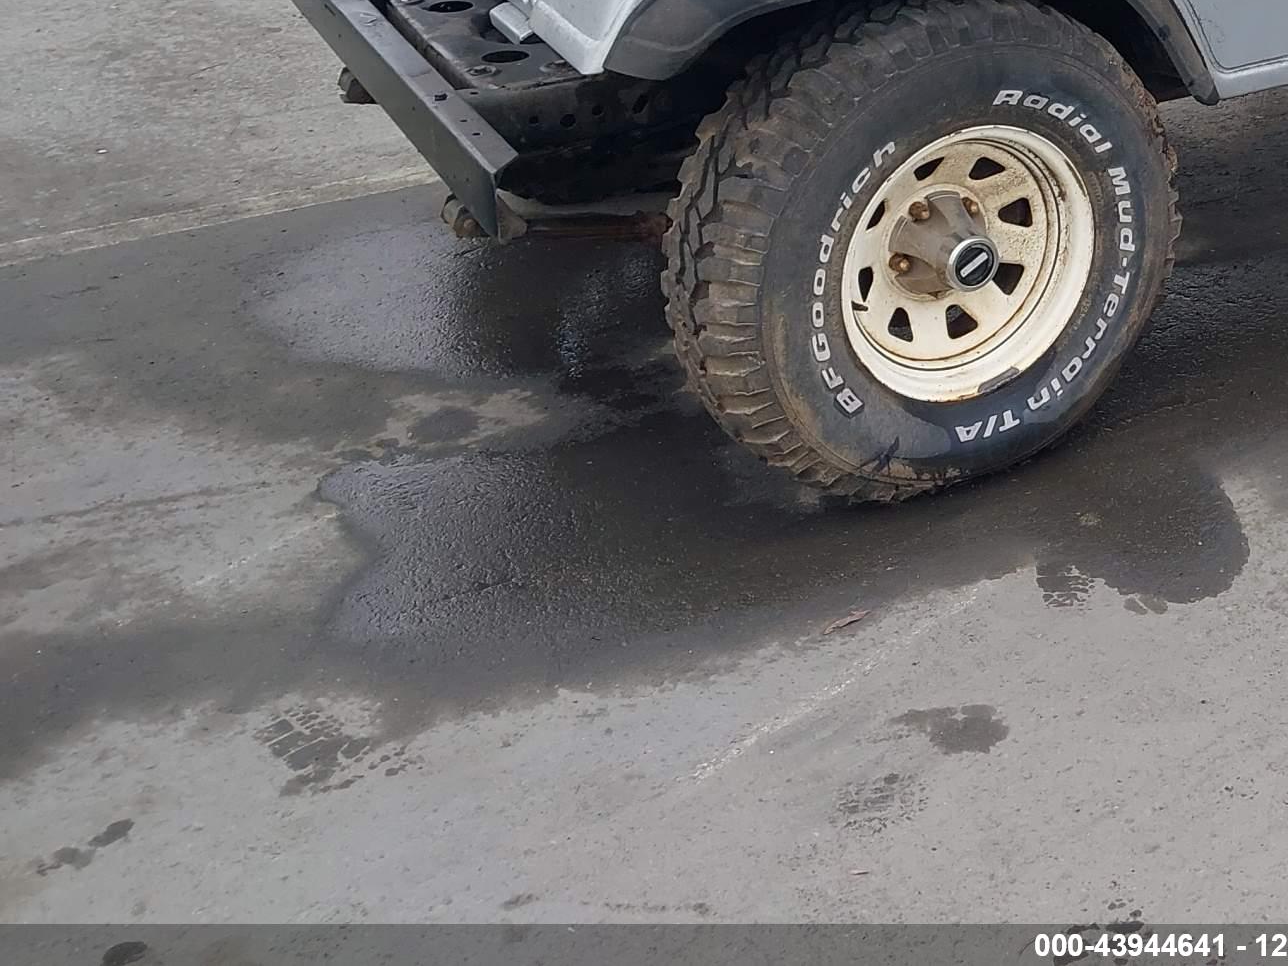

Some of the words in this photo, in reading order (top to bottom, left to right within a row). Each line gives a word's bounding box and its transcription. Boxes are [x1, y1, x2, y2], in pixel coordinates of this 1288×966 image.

[992, 89, 1113, 155] Radial
[810, 140, 896, 418] BFGoodrich
[1025, 164, 1138, 413] Mud-Terrain
[954, 407, 1022, 444] T/A
